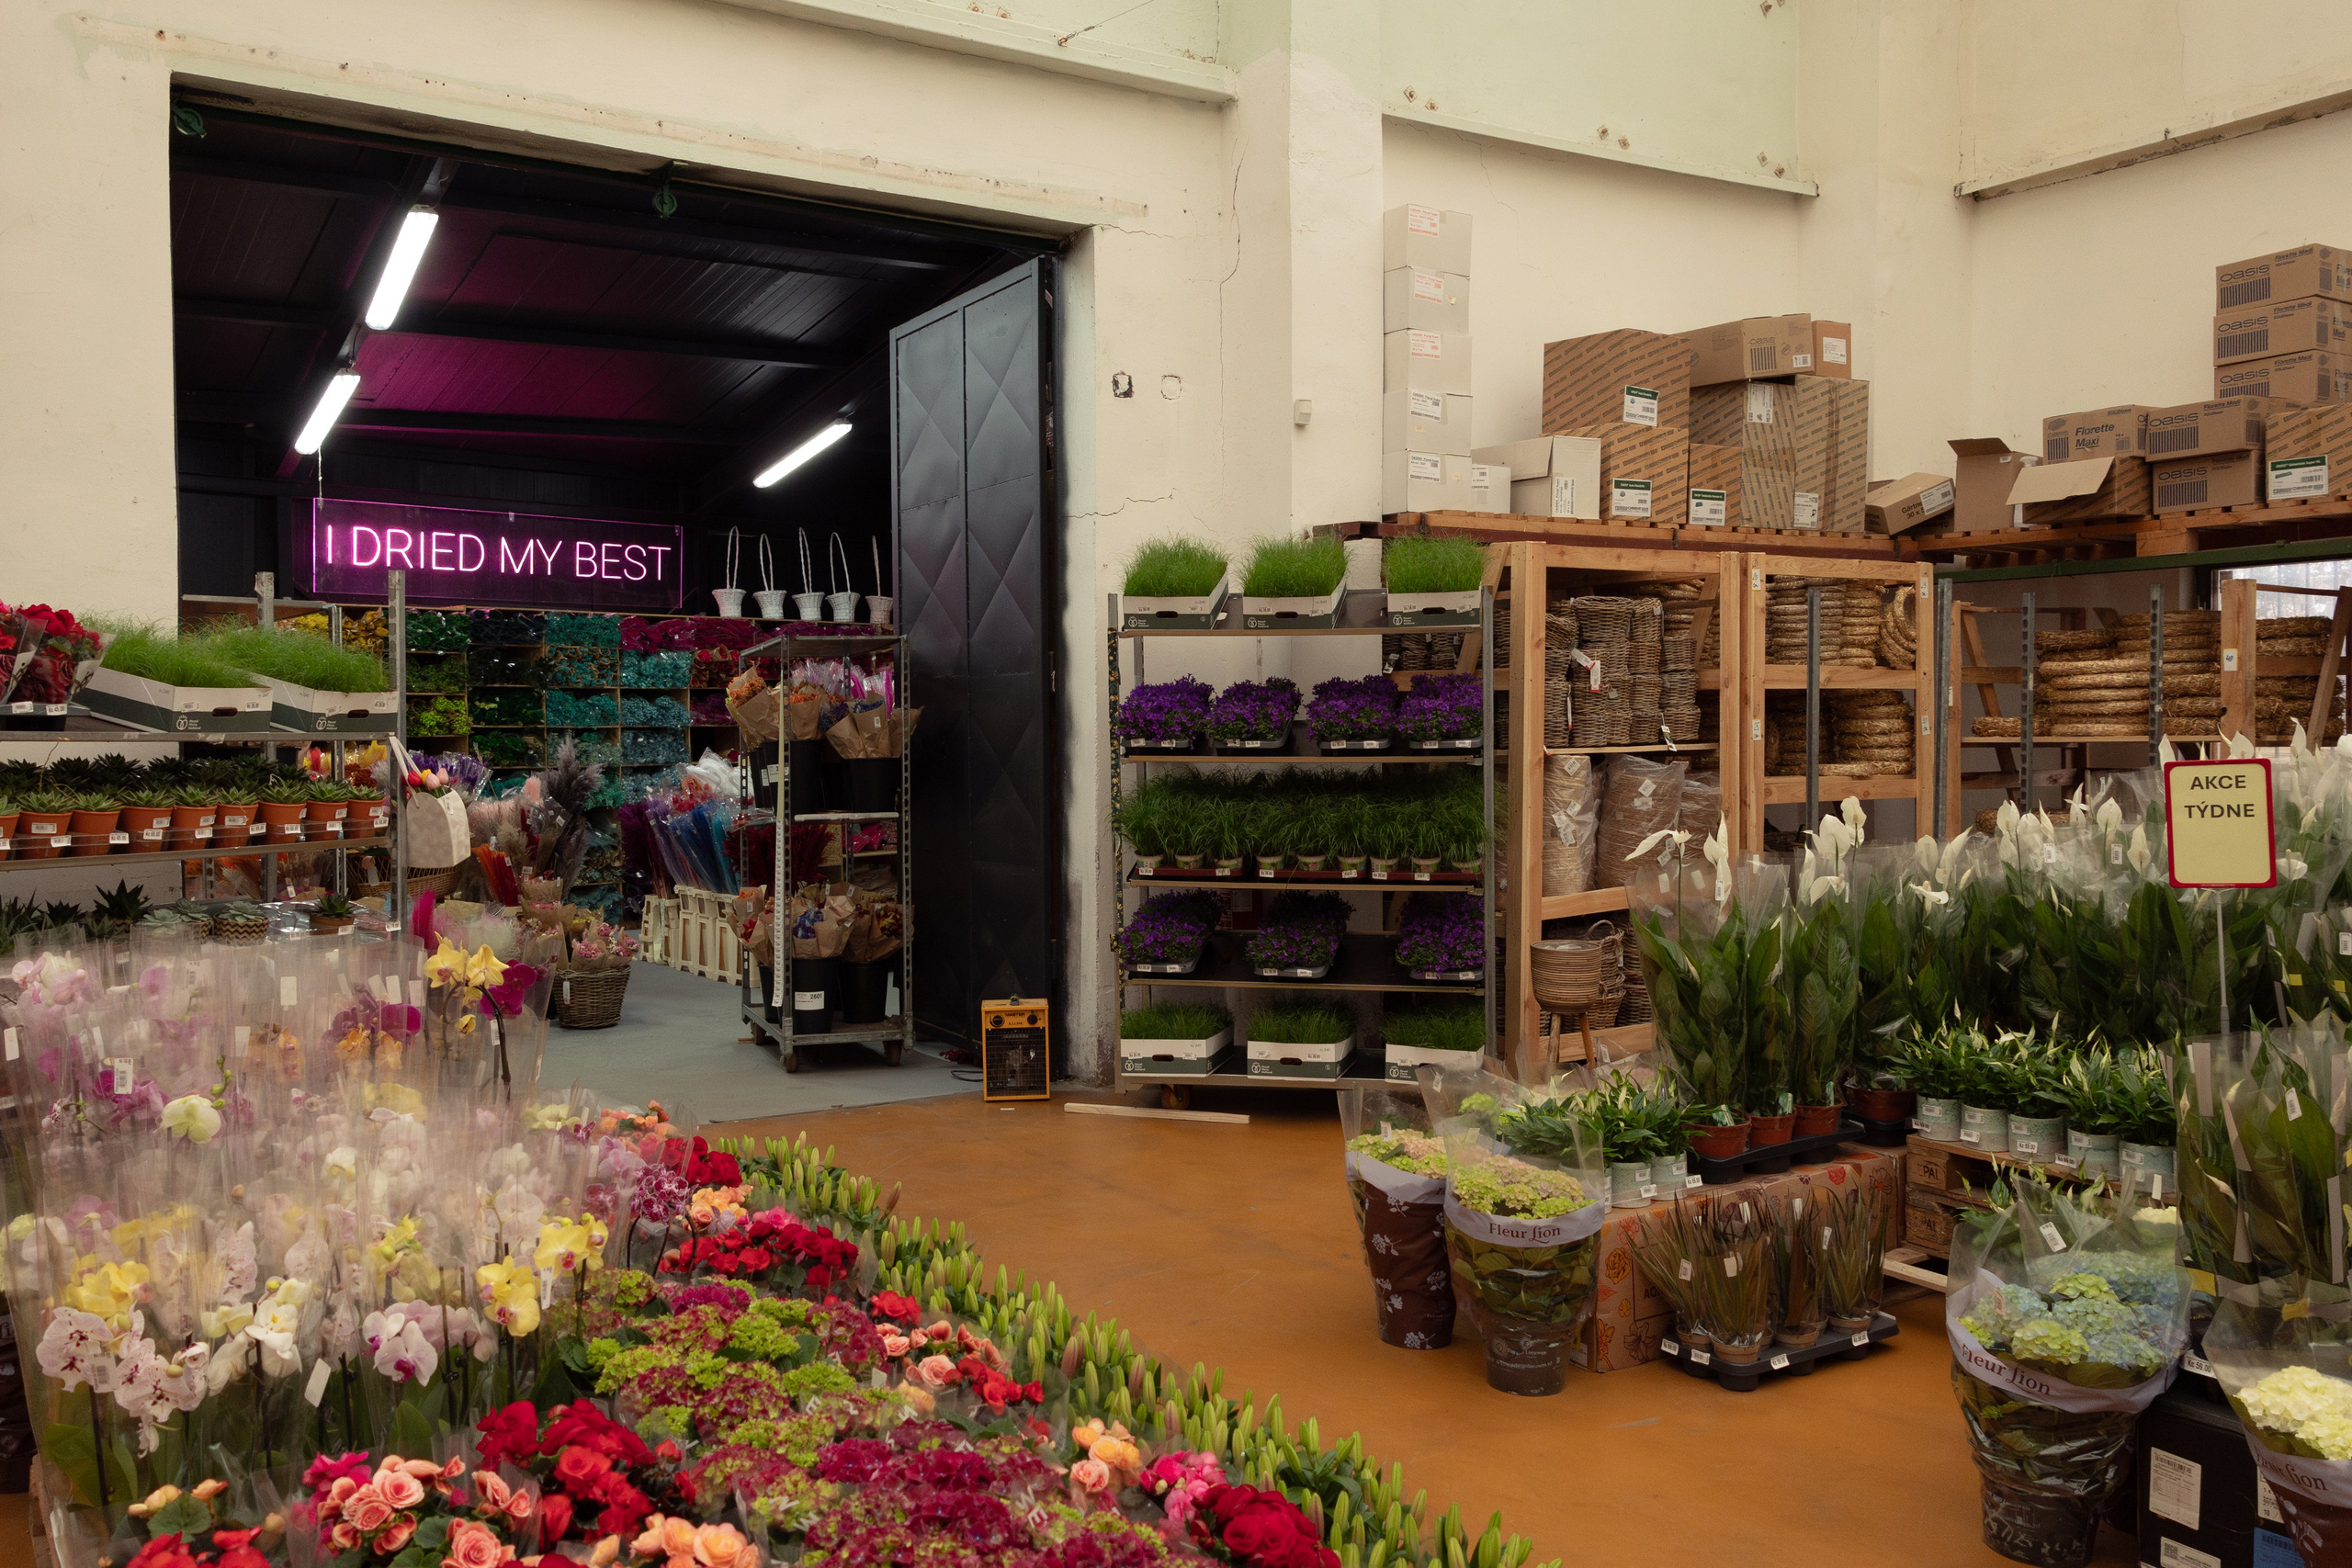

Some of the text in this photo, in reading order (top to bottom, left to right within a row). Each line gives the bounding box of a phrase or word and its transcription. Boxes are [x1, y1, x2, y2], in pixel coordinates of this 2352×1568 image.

[2075, 423, 2115, 437] Florette
[2075, 436, 2099, 447] Maxi
[327, 525, 672, 581] I DRIED MY BEST
[2190, 775, 2246, 790] AKCE
[2184, 801, 2256, 818] TÝDNE
[1489, 1223, 1560, 1244] Fleur Lion
[1962, 1343, 2007, 1376] Fleur
[2196, 1362, 2211, 1372] 59.00
